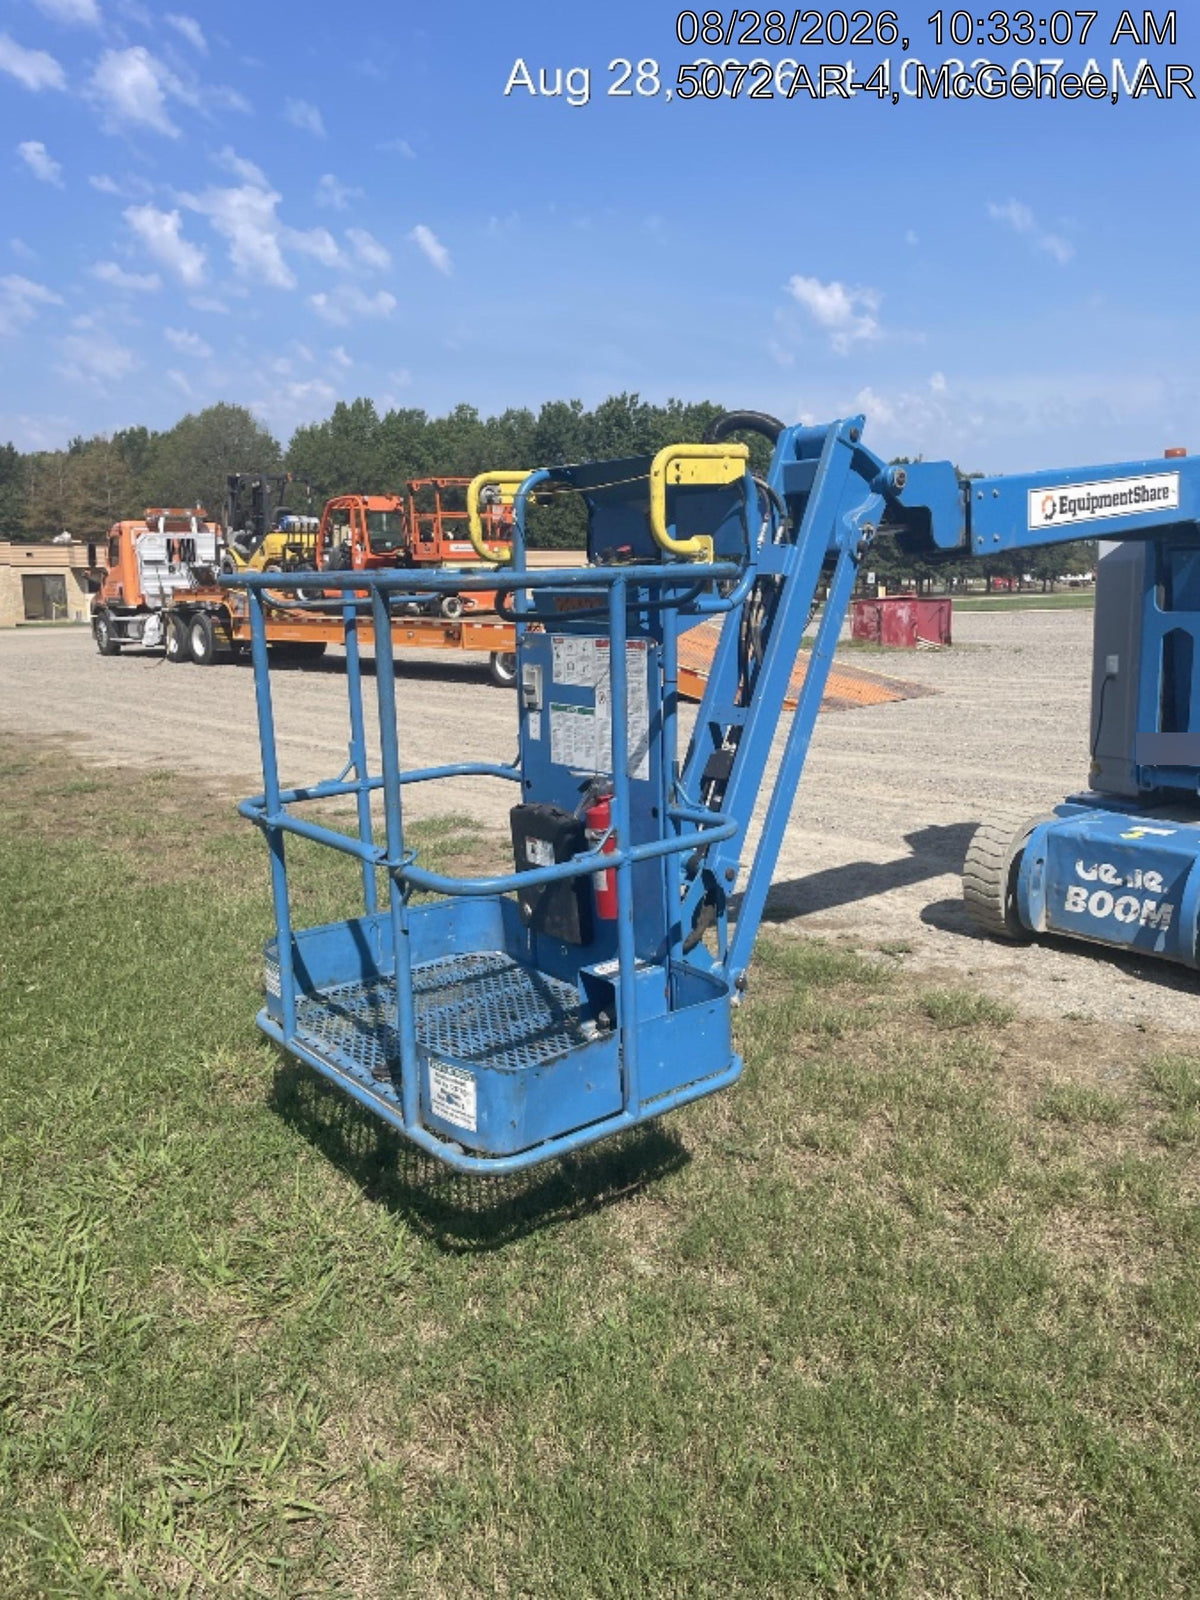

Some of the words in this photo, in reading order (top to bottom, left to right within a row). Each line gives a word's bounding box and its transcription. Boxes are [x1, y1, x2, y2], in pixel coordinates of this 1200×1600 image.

[1058, 484, 1170, 517] EquipmentShare
[1075, 858, 1164, 894] Geie
[1064, 885, 1175, 933] BOOM
